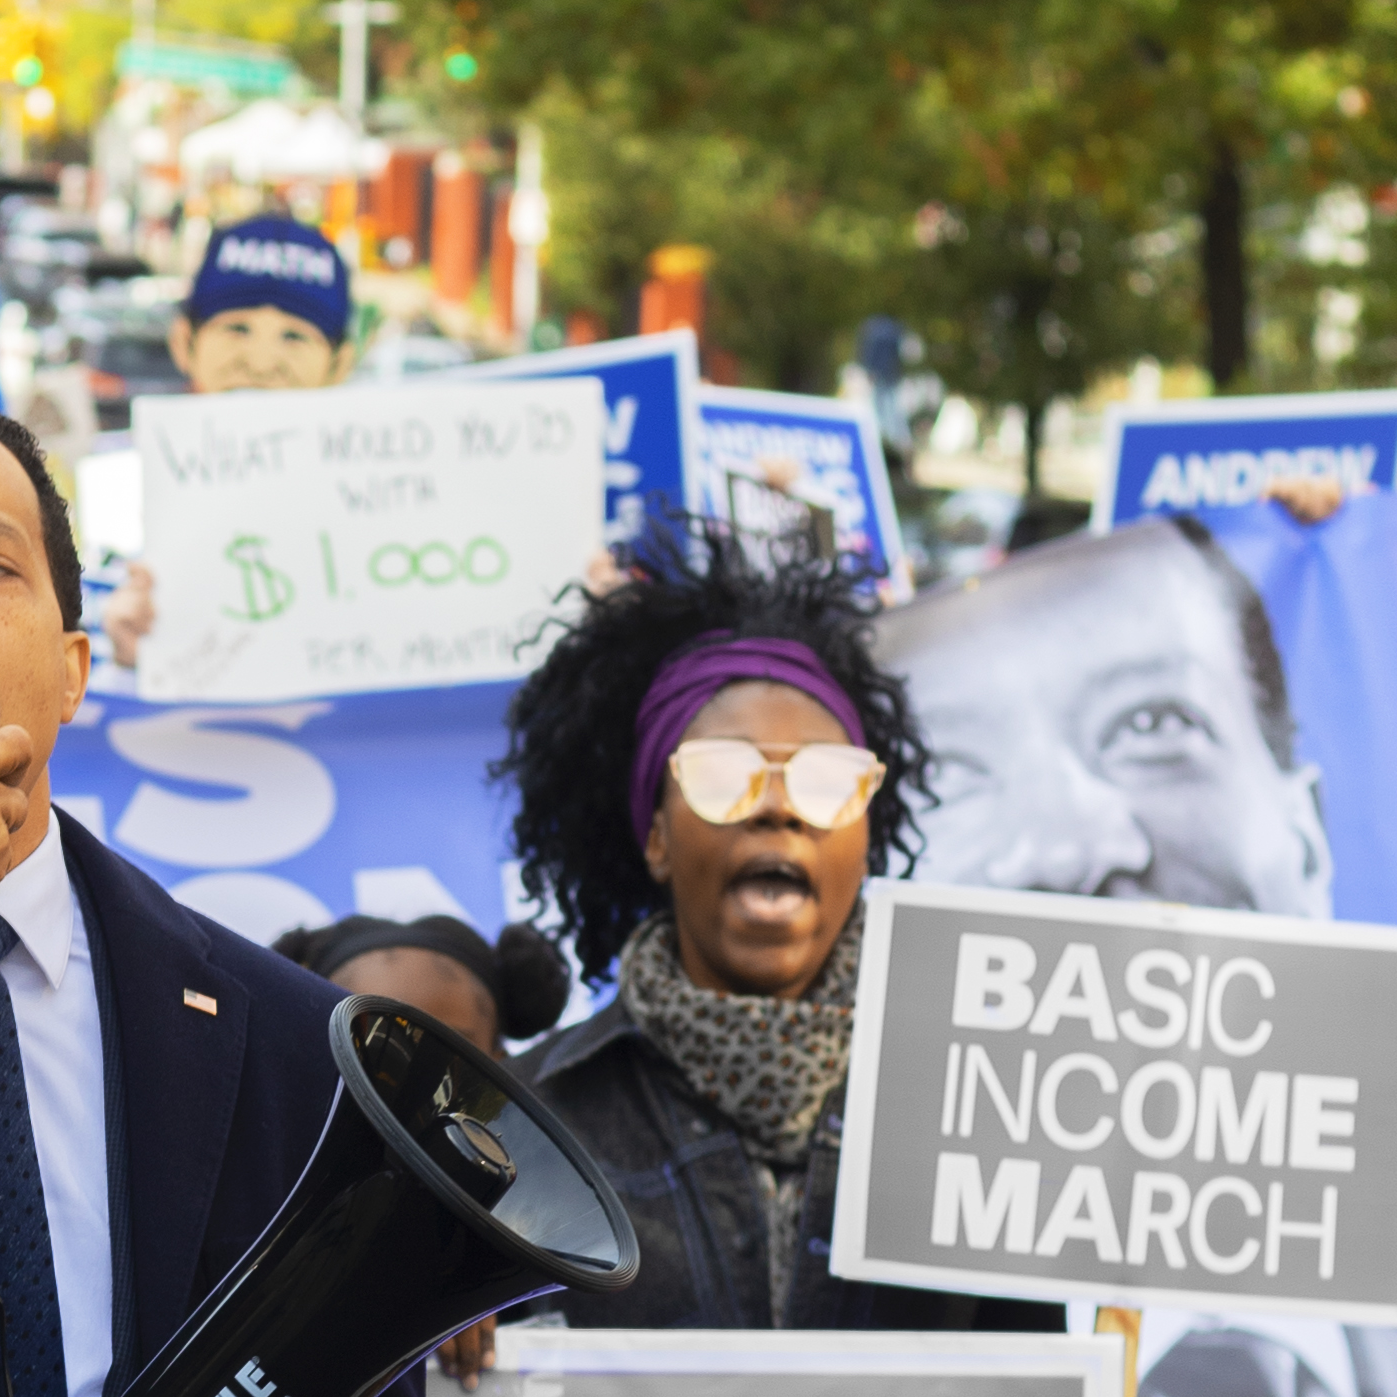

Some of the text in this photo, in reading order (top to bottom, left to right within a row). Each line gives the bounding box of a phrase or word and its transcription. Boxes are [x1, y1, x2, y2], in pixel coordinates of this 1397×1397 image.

[217, 234, 337, 288] MATH
[153, 416, 300, 486] WHAT
[336, 473, 440, 513] WITH
[952, 932, 1276, 1057] BASIC
[941, 1042, 1360, 1172] INCOME
[930, 1152, 1339, 1281] MARCH
